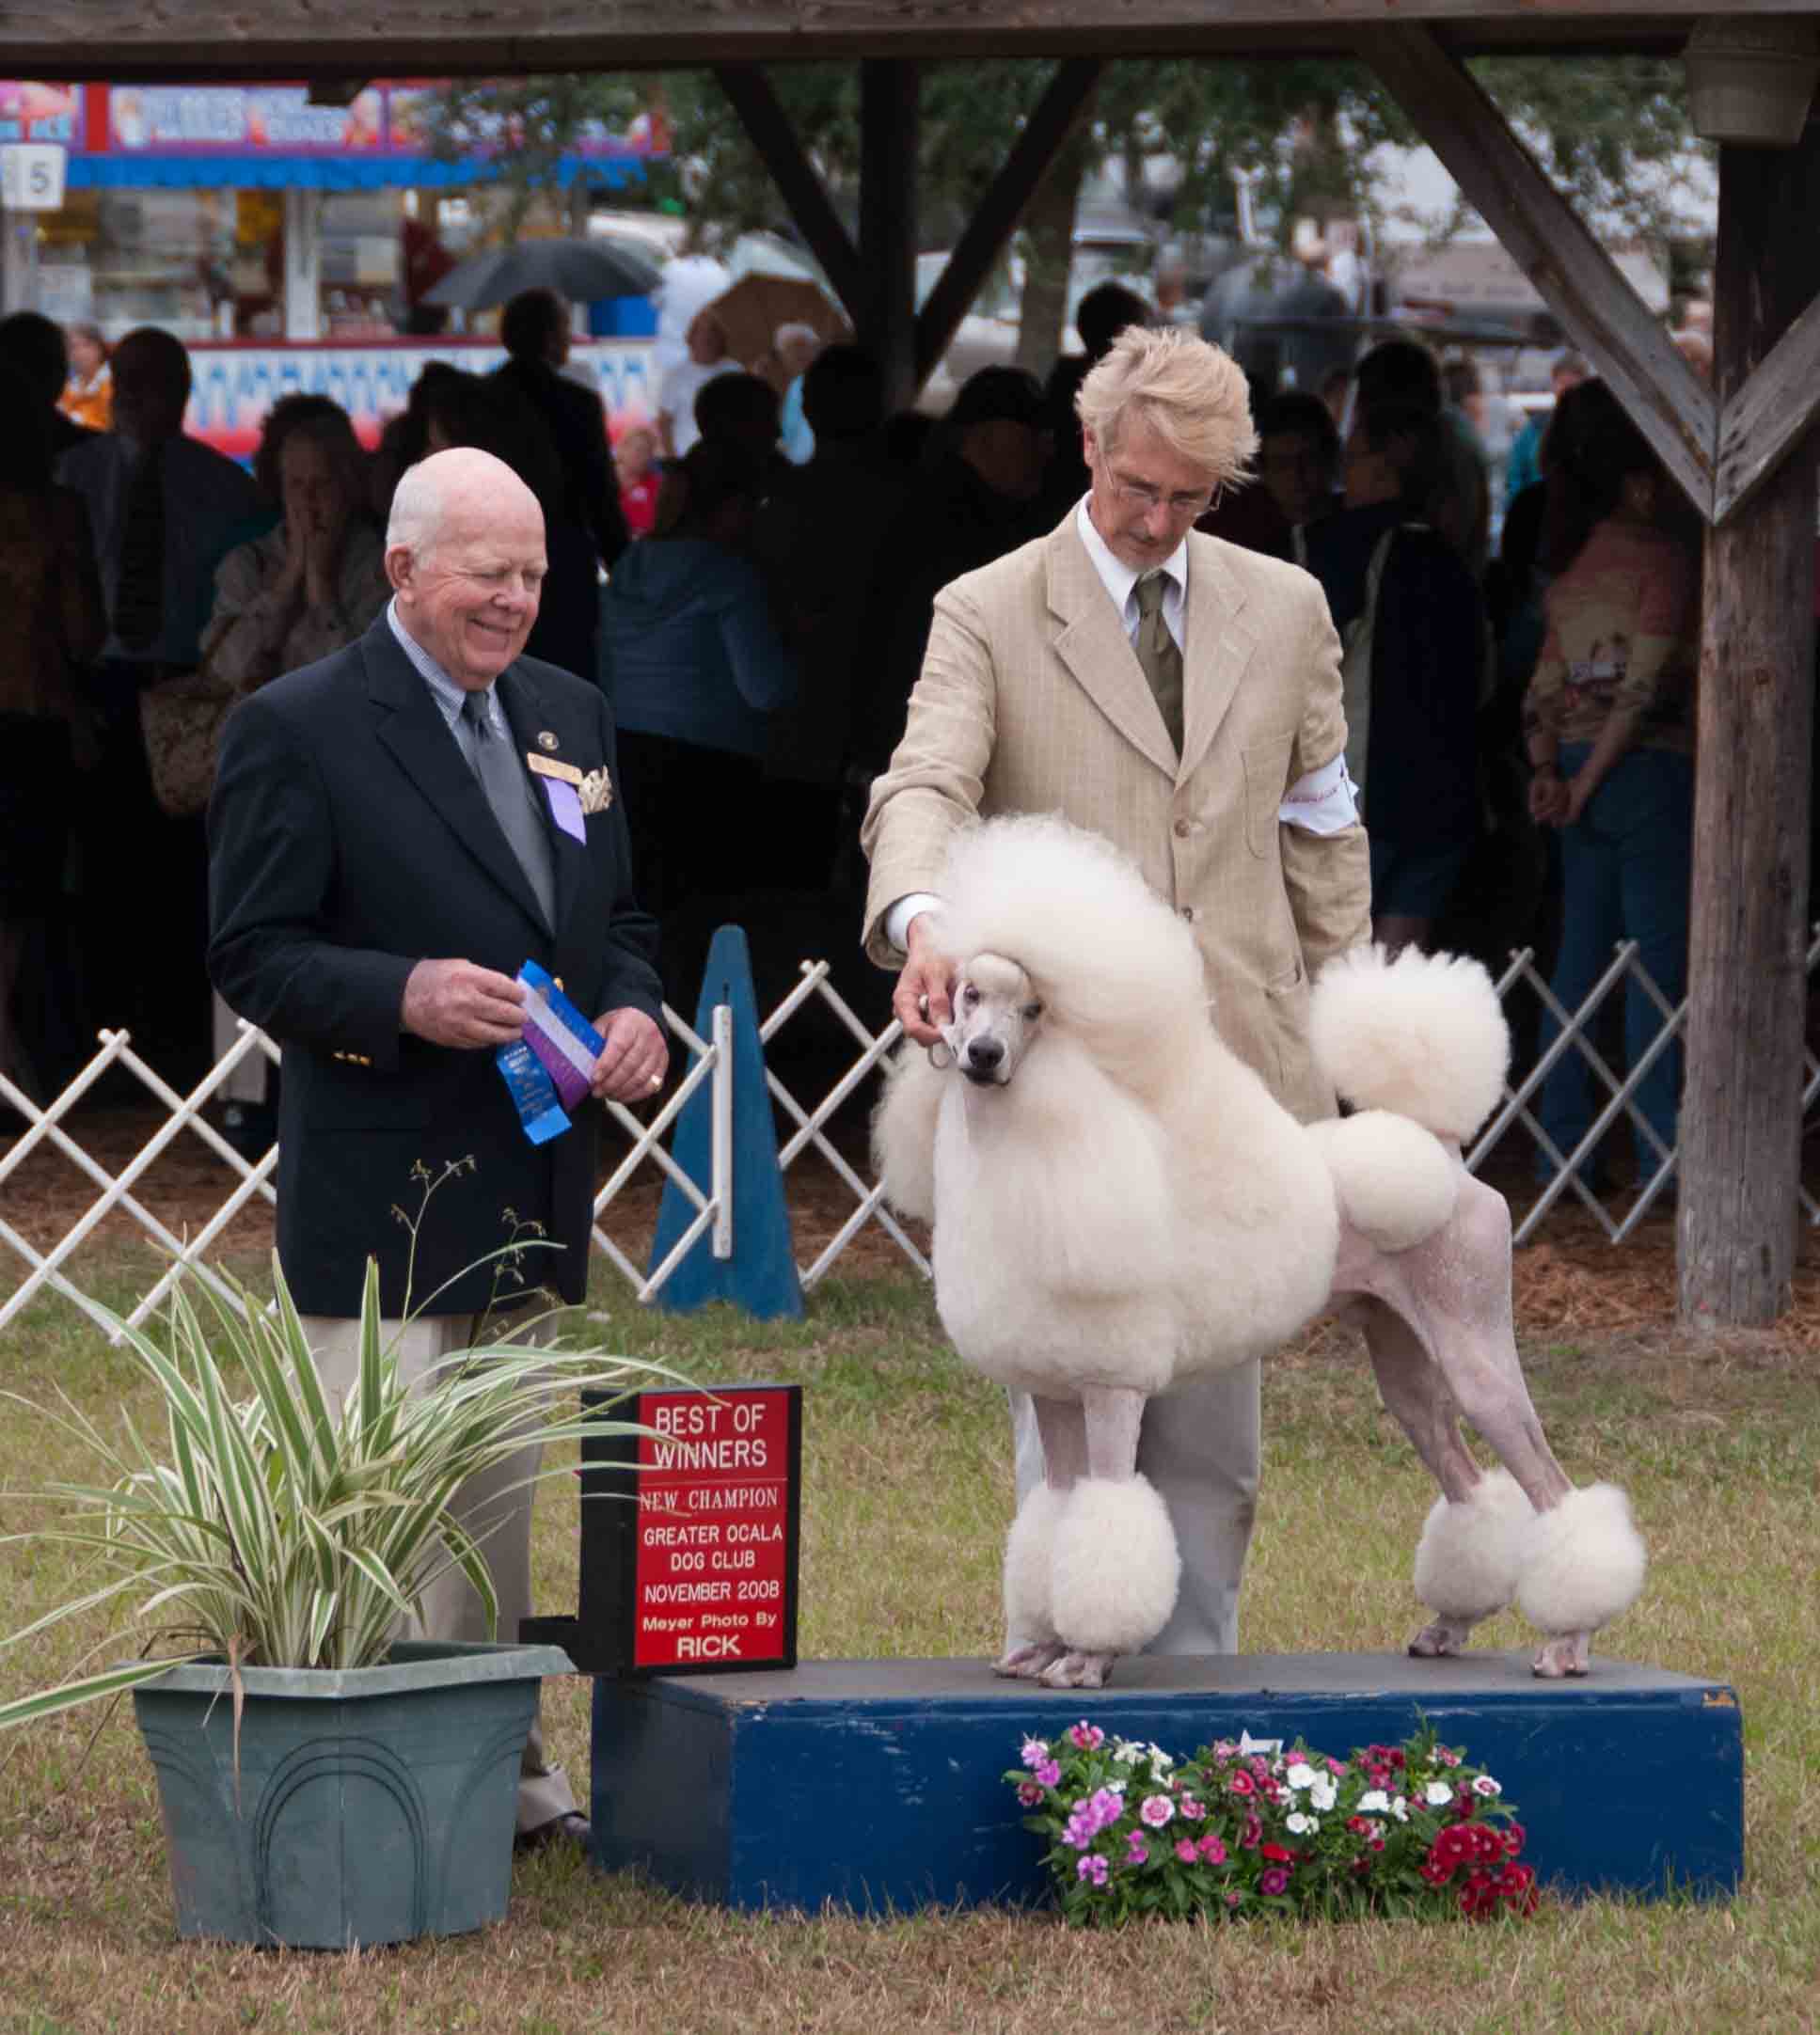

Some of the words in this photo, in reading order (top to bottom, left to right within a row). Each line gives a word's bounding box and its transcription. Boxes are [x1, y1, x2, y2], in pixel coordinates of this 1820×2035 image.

[30, 161, 51, 195] 5
[656, 1405, 722, 1434] BEST
[734, 1404, 766, 1432] OF
[654, 1439, 768, 1469] WINNERS
[640, 1491, 679, 1512] NEW
[688, 1487, 779, 1510] CHAMPION
[643, 1525, 720, 1547] GREATER
[727, 1523, 783, 1543] OCALA
[671, 1553, 704, 1571] DOG
[712, 1550, 755, 1570] CLUB
[644, 1582, 731, 1603] NOVEMBER
[737, 1580, 780, 1599] 2008
[642, 1616, 694, 1633] Meyer
[702, 1614, 749, 1628] Photo
[756, 1611, 777, 1627] By
[677, 1634, 741, 1659] RICK
